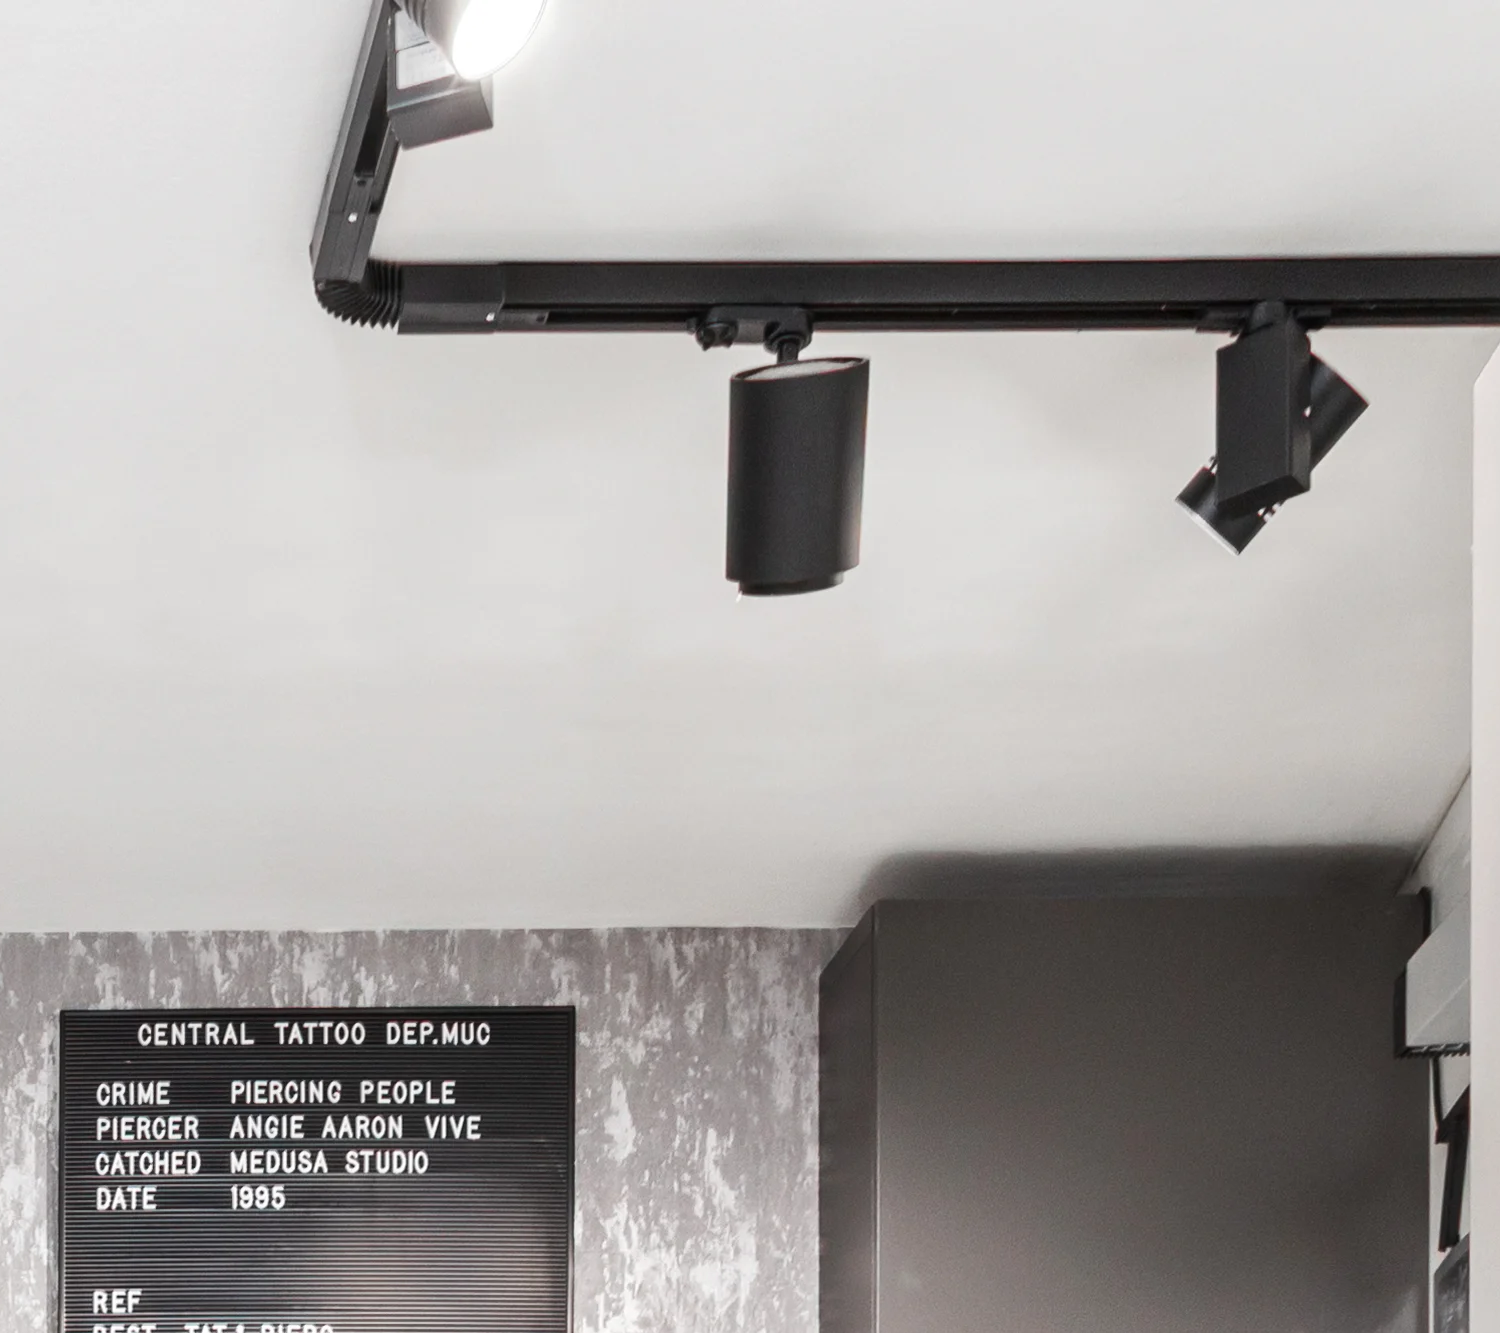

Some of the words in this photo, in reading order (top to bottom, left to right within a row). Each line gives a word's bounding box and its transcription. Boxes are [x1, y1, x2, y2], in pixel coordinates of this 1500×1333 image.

[138, 1023, 254, 1046] CENTRAL
[274, 1022, 366, 1045] TATTOO
[387, 1022, 490, 1045] DEP.MUC
[96, 1081, 170, 1106] CRIME
[231, 1081, 342, 1104] PIERCING
[360, 1080, 456, 1104] PEOPLE
[96, 1116, 199, 1141] PIERCER
[230, 1115, 304, 1139] ANGIE
[322, 1115, 403, 1139] AARON
[425, 1115, 481, 1140] VIVE
[95, 1150, 201, 1176] CATCHED
[230, 1150, 328, 1174] MEDUSA
[345, 1150, 429, 1174] STUDIO
[96, 1186, 157, 1211] DATE
[230, 1184, 286, 1210] 1995
[93, 1289, 142, 1314] REF
